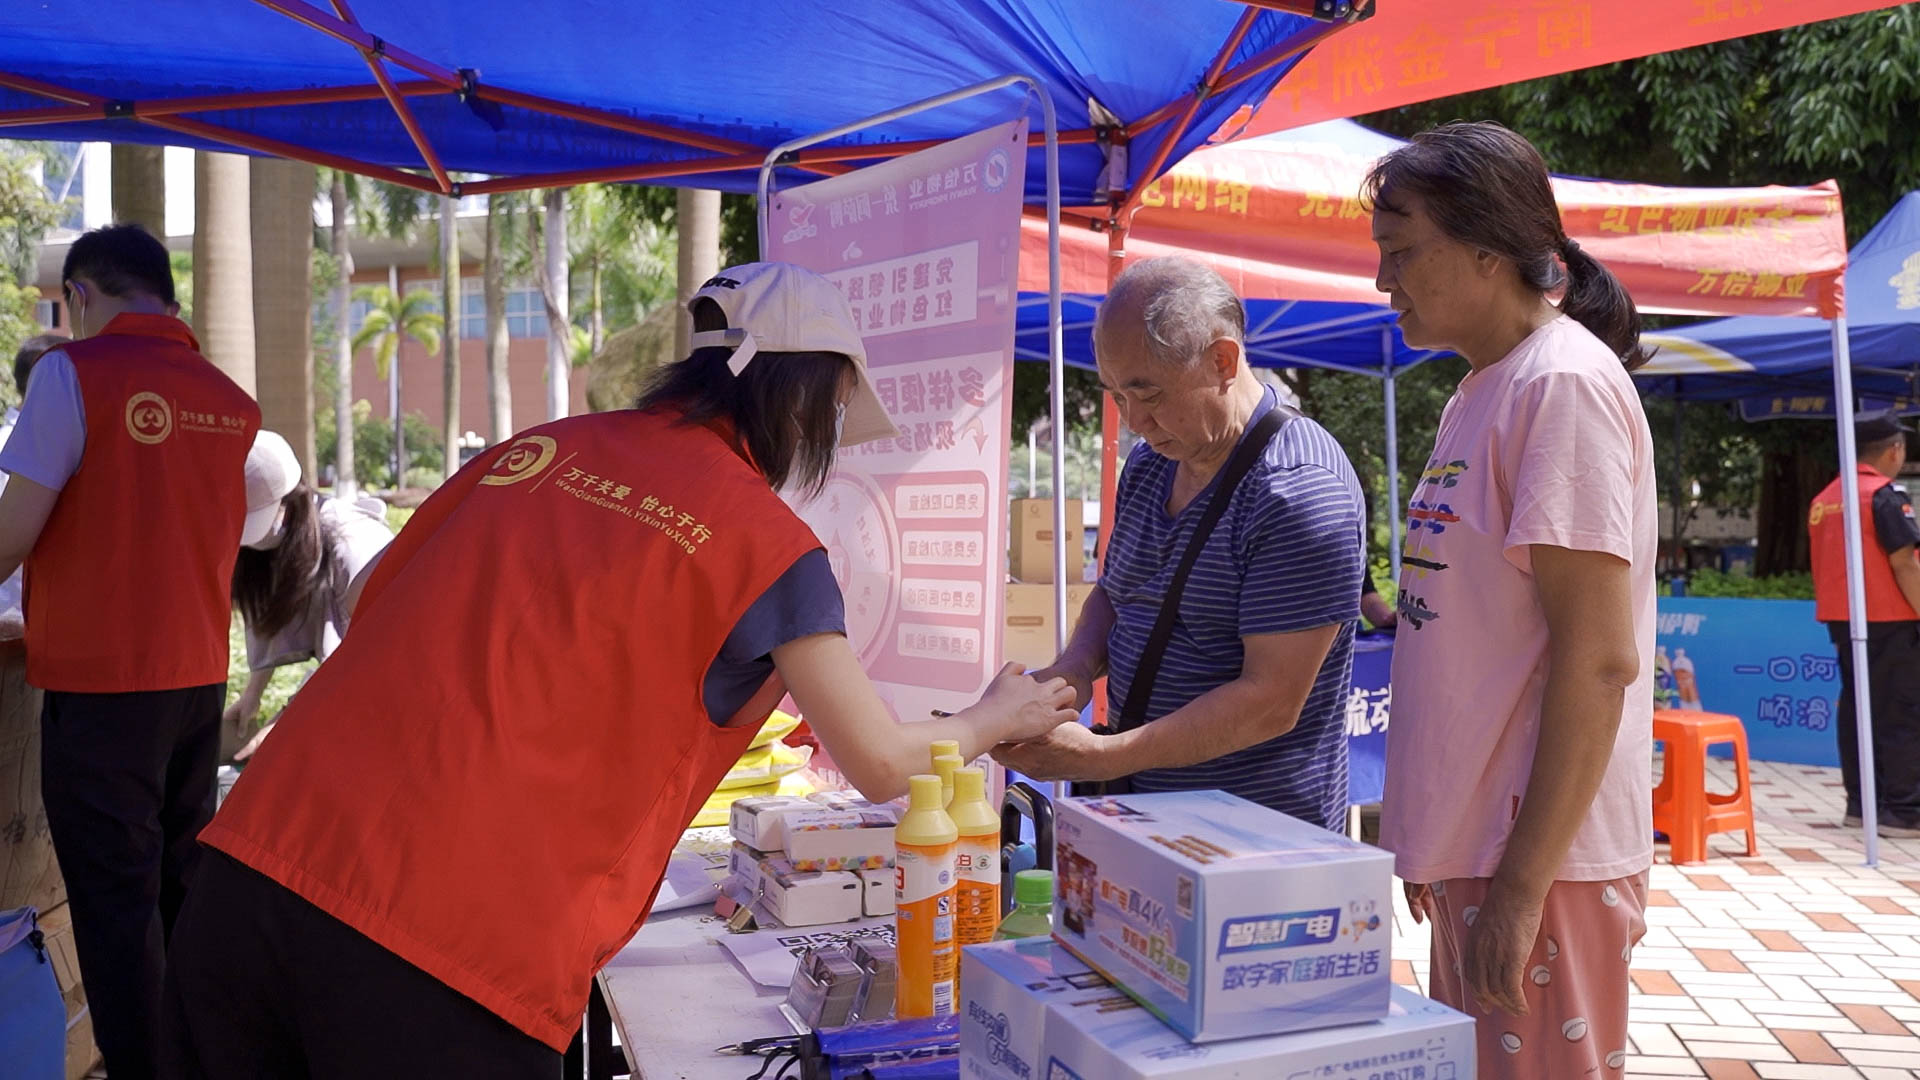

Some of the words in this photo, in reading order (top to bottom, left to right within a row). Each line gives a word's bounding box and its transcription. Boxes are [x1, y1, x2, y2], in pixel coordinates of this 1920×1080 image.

[563, 467, 632, 500] 万千关爱
[639, 495, 712, 544] 怡心于行
[1226, 914, 1334, 948] 智慧广电
[1222, 949, 1381, 990] 数字家庭新生活
